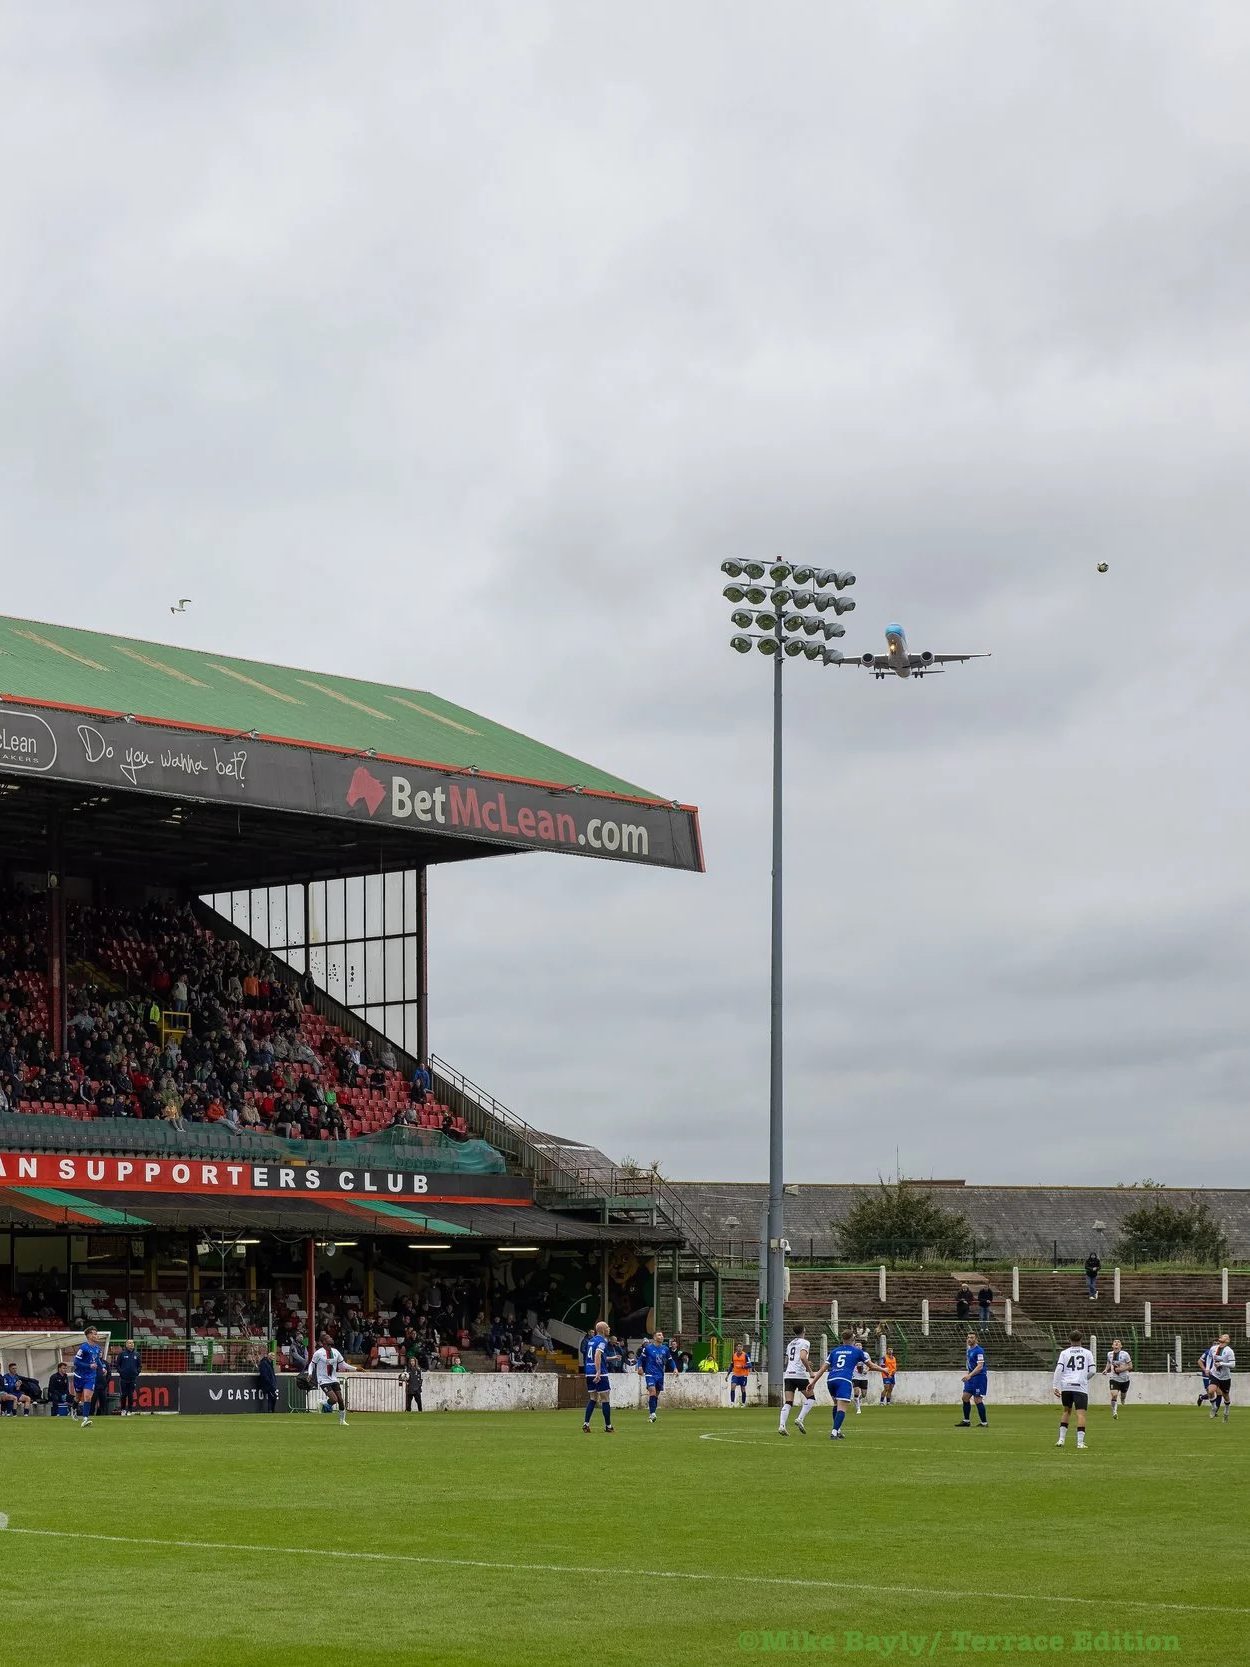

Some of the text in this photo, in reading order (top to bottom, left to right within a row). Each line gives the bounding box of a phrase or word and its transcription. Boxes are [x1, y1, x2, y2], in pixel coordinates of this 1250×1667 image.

[76, 725, 114, 762] Do
[120, 748, 154, 785] you
[213, 748, 248, 788] bet?
[391, 775, 649, 856] BetMcLean.com
[59, 1158, 321, 1189] SUPPORTERS
[338, 1171, 429, 1194] CLUB
[587, 1345, 594, 1361] 4
[789, 1346, 796, 1361] 9
[836, 1354, 847, 1368] 5
[1066, 1355, 1085, 1372] 43
